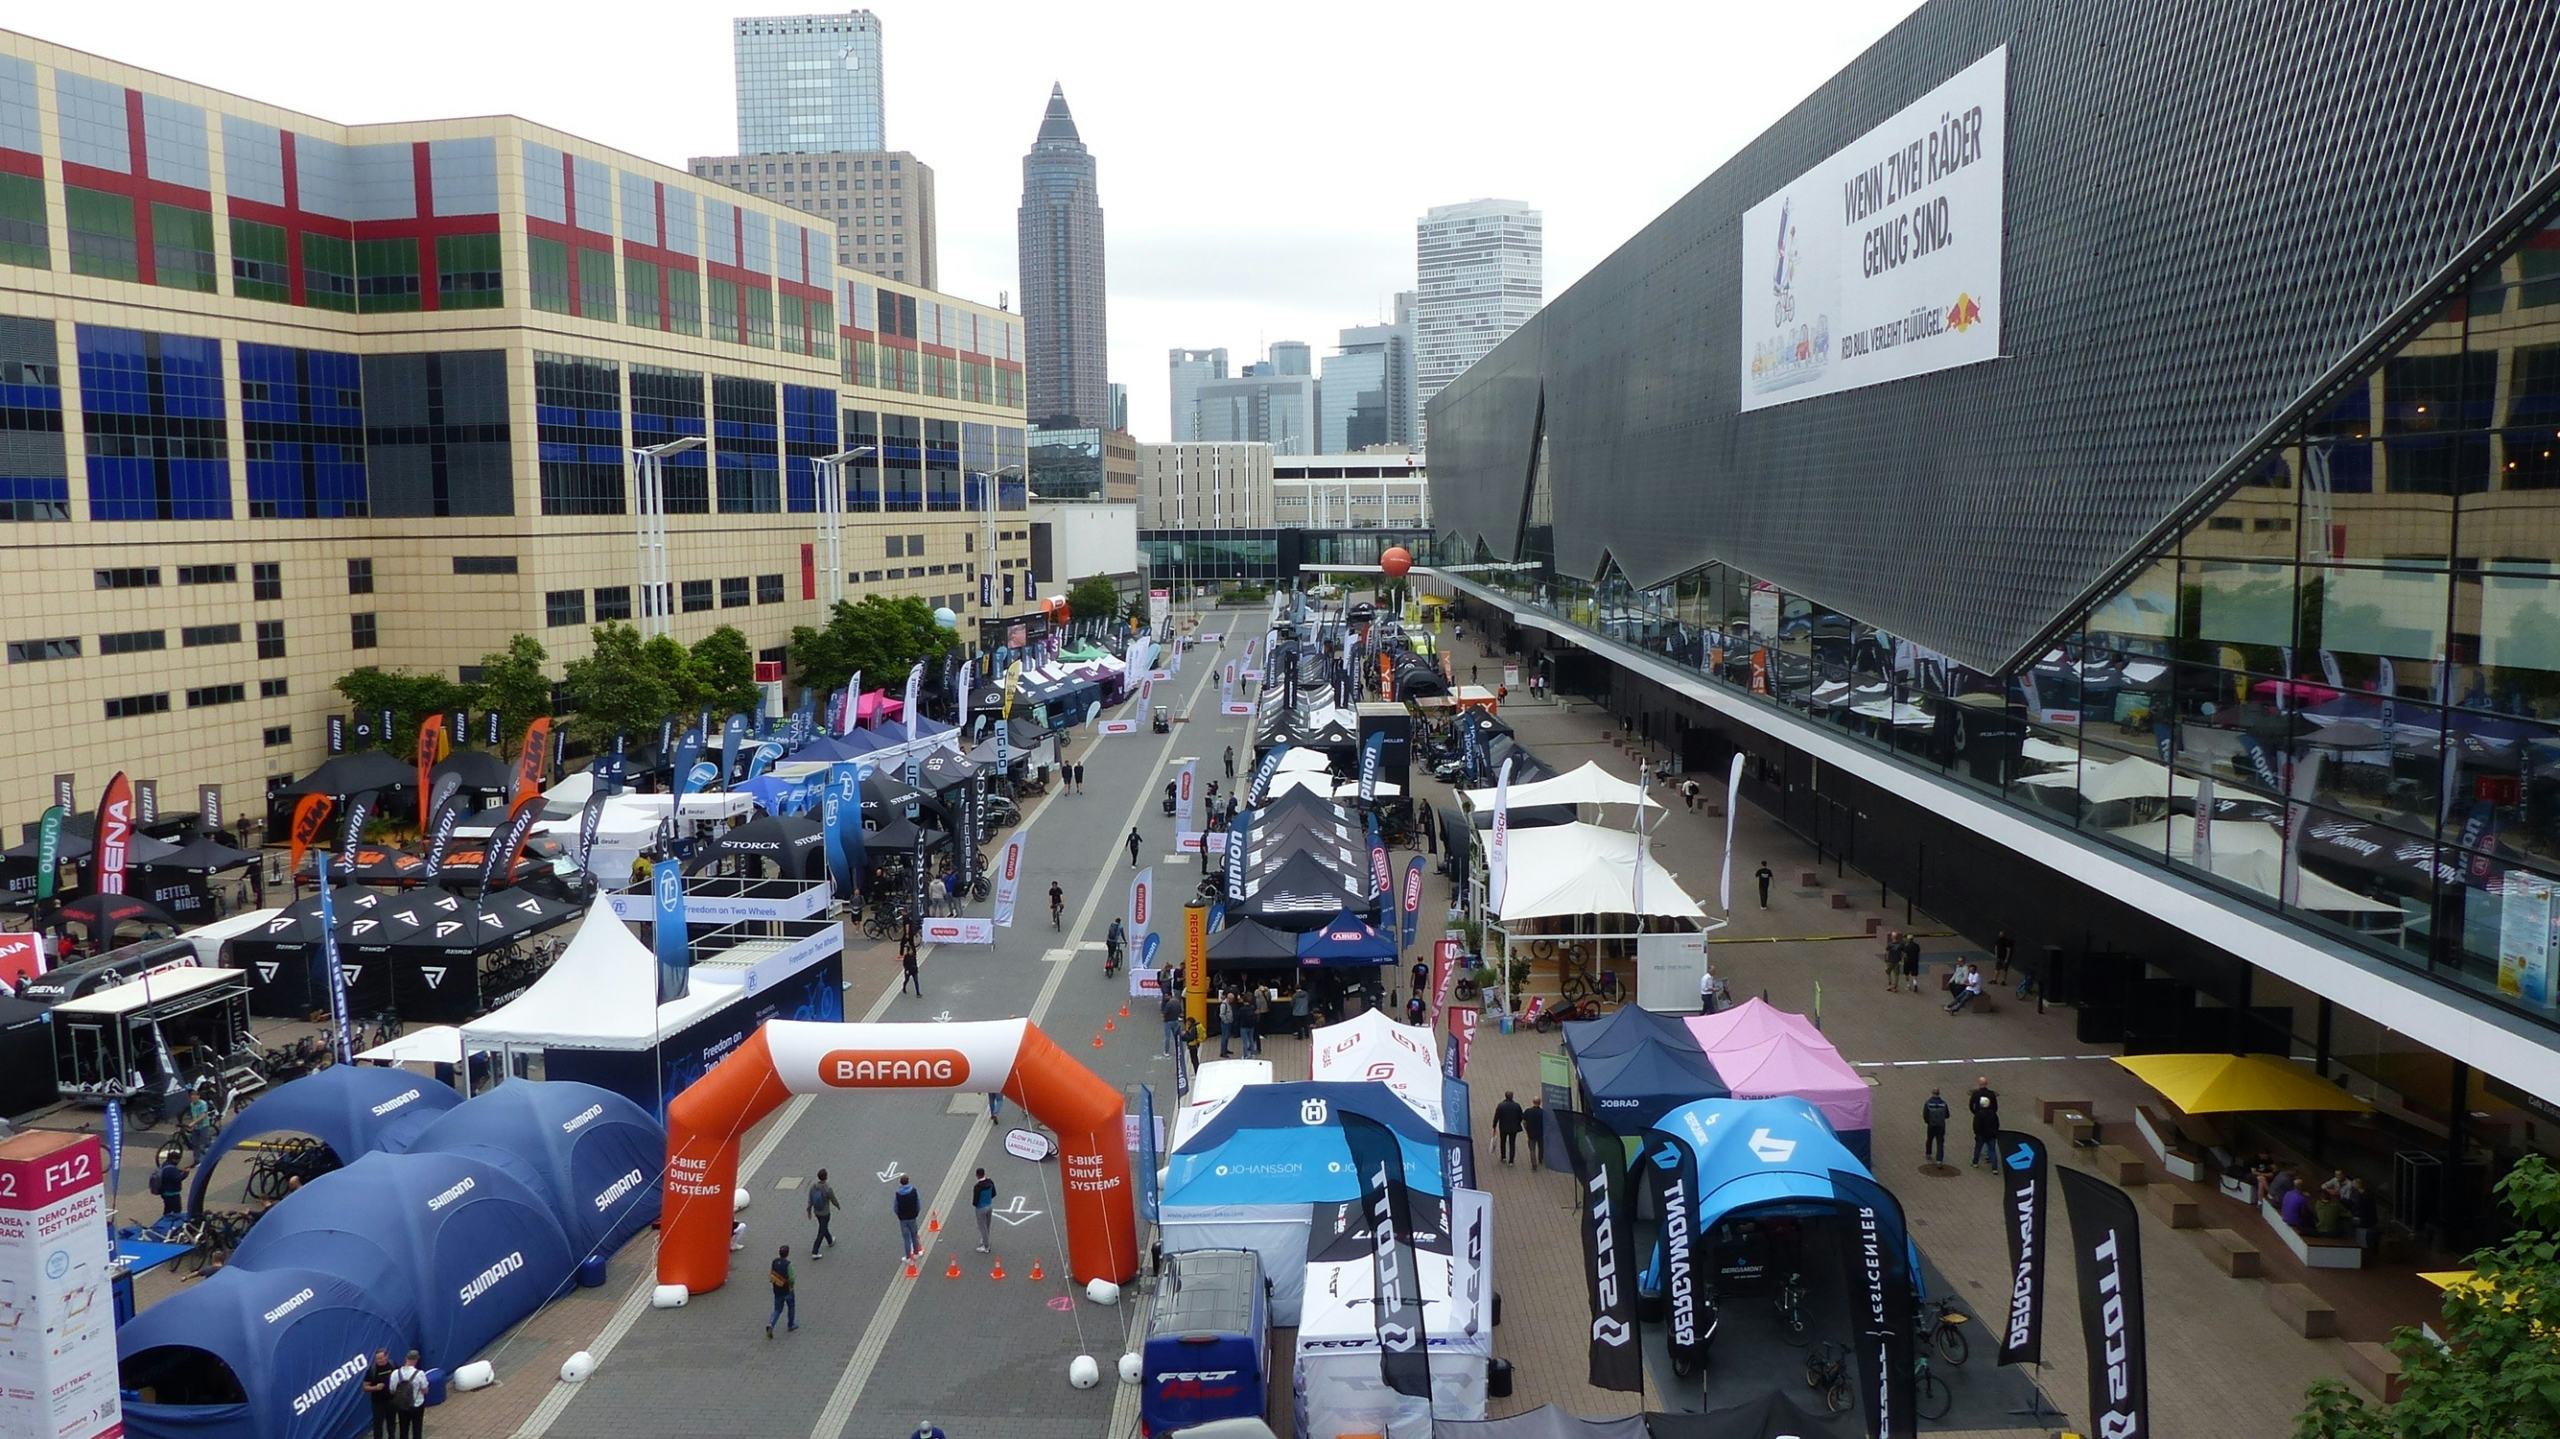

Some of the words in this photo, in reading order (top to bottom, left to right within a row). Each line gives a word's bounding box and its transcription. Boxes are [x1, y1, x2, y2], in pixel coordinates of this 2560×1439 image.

[1845, 162, 1883, 226] WENN
[1888, 137, 1923, 206] ZWEI
[1928, 106, 1982, 184] RÄDER
[1864, 214, 1908, 278] GENUG
[1913, 196, 1952, 259] SIND.
[1842, 335, 1852, 360] RED
[1854, 330, 1869, 357] BULL
[1871, 321, 1902, 350] VERLEIHT
[526, 730, 544, 782] KTM
[1248, 754, 1277, 807] pinion
[1360, 747, 1377, 801] pinion
[890, 791, 920, 805] STORCK
[977, 769, 986, 840] STORCK
[297, 799, 327, 845] KTM
[346, 804, 366, 863] RAYMON
[430, 808, 456, 866] RAYMON
[505, 810, 531, 860] AYMON
[1496, 812, 1504, 847] BOSCH
[103, 800, 128, 895] SENA
[721, 841, 780, 850] STORCK
[794, 832, 825, 848] STORC
[917, 829, 926, 916] STORCK
[1229, 830, 1245, 901] pinion
[9, 875, 37, 892] BETTE
[156, 885, 191, 901] BETTER
[1405, 871, 1418, 908] ABUS
[175, 897, 201, 911] RIDES
[684, 905, 717, 913] Freedom
[749, 907, 776, 916] Wheels
[1190, 913, 1199, 986] REGISTRATION
[27, 986, 65, 995] SENA
[703, 1034, 731, 1058] Freedom
[733, 1031, 742, 1042] on
[837, 1060, 951, 1080] BAFANG
[371, 1089, 420, 1116] SHIMANO
[1601, 1099, 1639, 1107] JOBRAD
[563, 1103, 603, 1133] SHIMANO
[1011, 1133, 1027, 1143] SLOW
[45, 1154, 92, 1192] F12
[671, 1156, 706, 1169] E-BIKE
[1068, 1155, 1103, 1166] E-BIKE
[1069, 1168, 1103, 1178] DRIVE
[595, 1169, 643, 1212] SHIMANO
[669, 1182, 721, 1196] SYSTEMS
[670, 1169, 704, 1183] DRIVE
[1070, 1176, 1120, 1192] SYSTEMS
[428, 1177, 475, 1210] SHIMANO
[38, 1208, 67, 1226] DEMO
[70, 1196, 96, 1212] AREA
[39, 1223, 61, 1238] TEST
[65, 1207, 98, 1225] TRACK
[0, 1229, 25, 1238] RACK
[459, 1252, 524, 1306] SHIMANO
[264, 1287, 314, 1323] SHIMANO
[1304, 1339, 1372, 1350] FELT
[293, 1352, 369, 1416] SHIMANO
[1156, 1371, 1237, 1384] FELT
